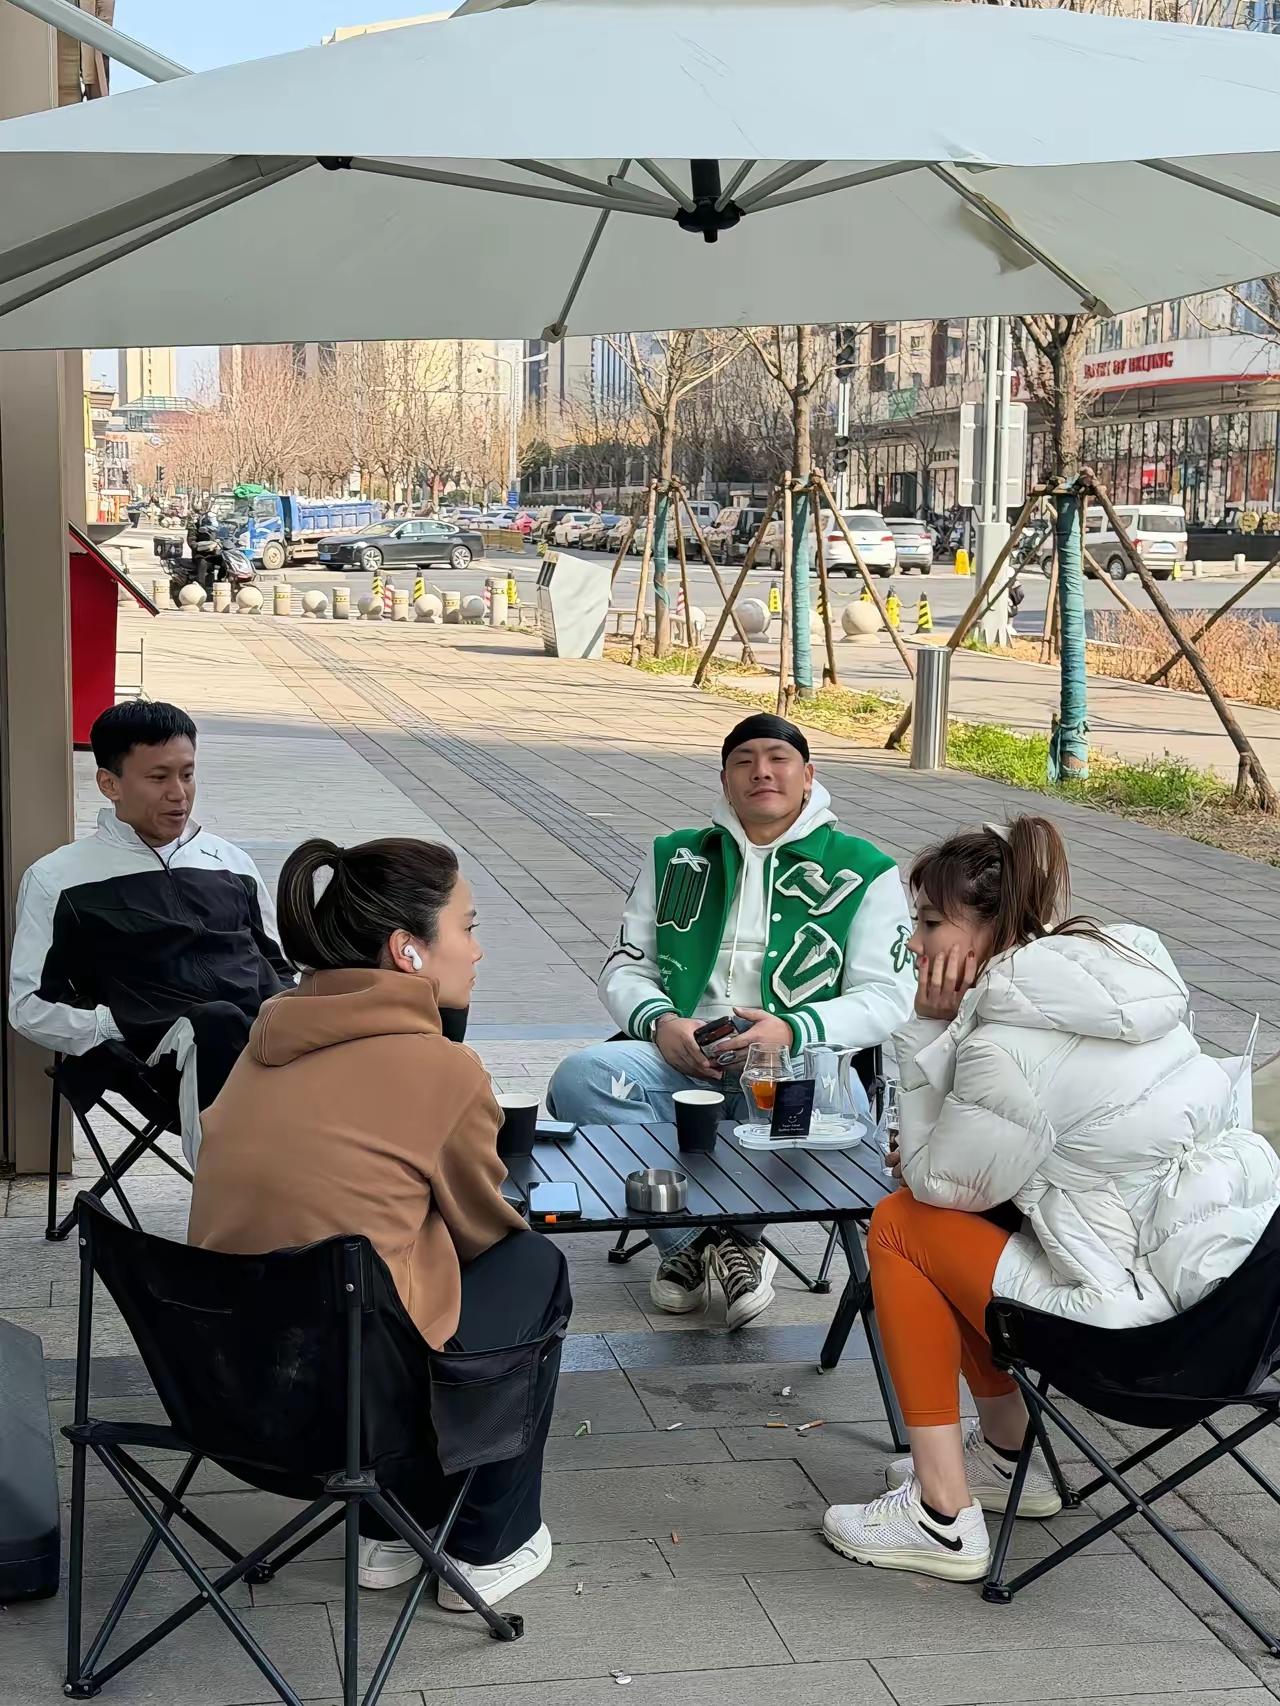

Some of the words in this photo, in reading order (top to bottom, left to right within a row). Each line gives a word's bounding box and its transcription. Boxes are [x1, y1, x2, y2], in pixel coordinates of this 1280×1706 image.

[1112, 358, 1127, 375] OF
[1128, 351, 1174, 373] BEIJING
[773, 921, 844, 1008] V
